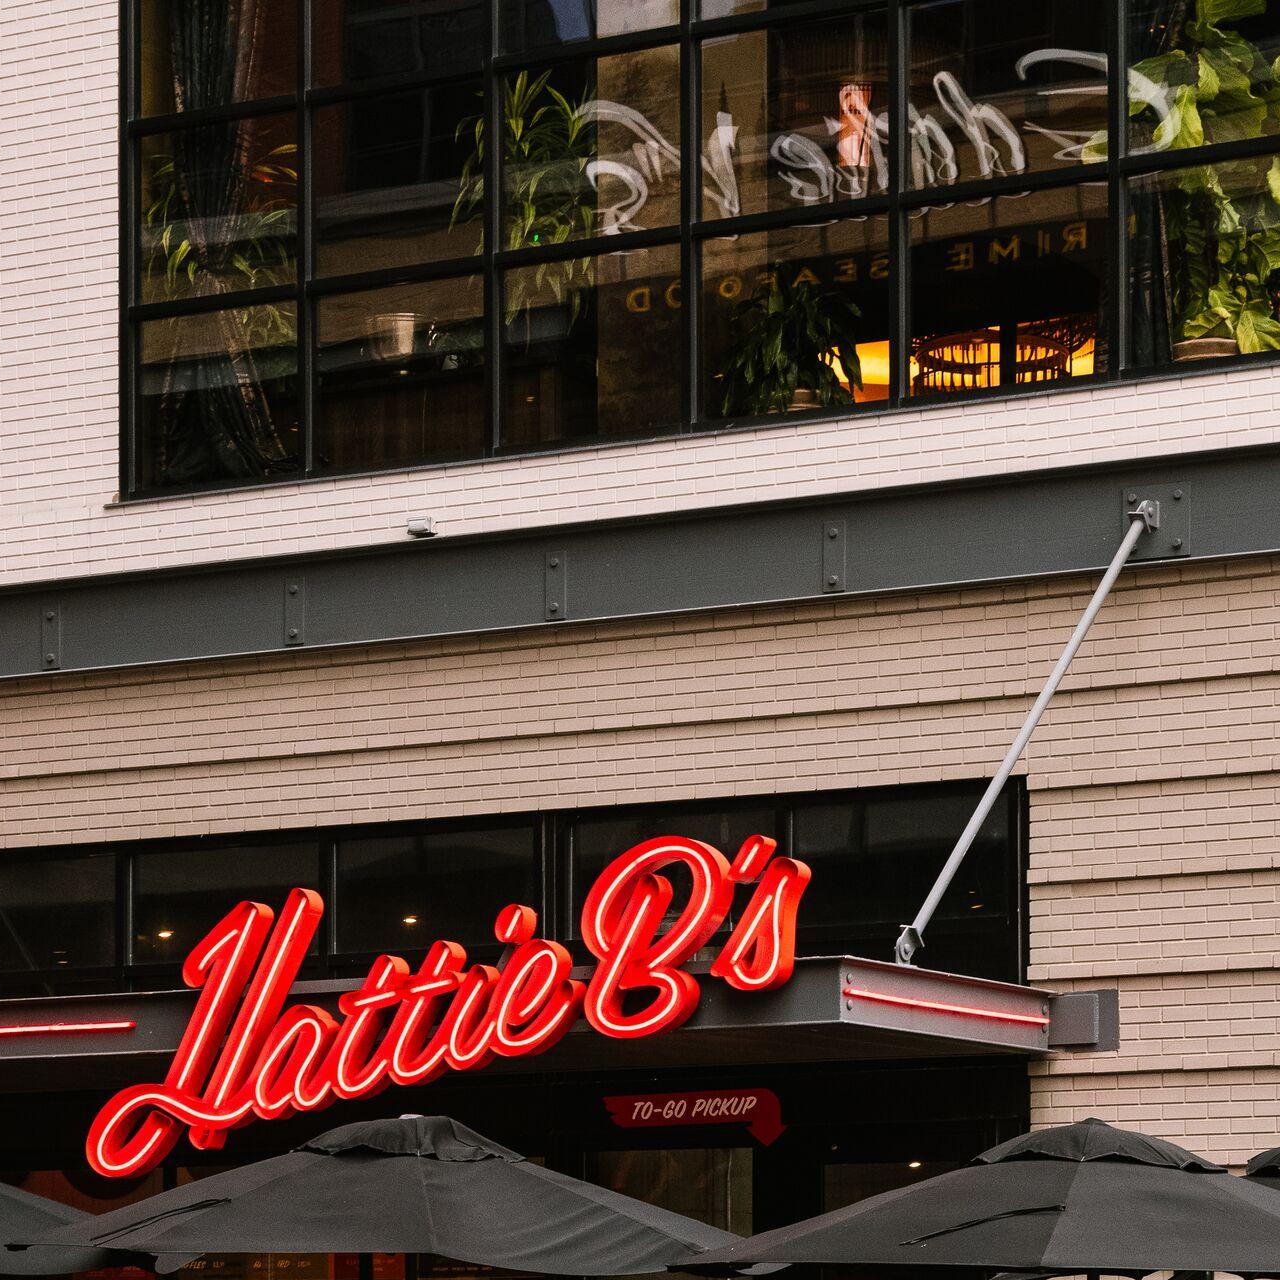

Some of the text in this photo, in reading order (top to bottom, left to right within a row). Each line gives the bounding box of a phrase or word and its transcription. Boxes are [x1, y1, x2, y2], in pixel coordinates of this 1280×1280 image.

[86, 834, 811, 1178] Hattie B's
[632, 1096, 757, 1120] TO-GO PICKUP
